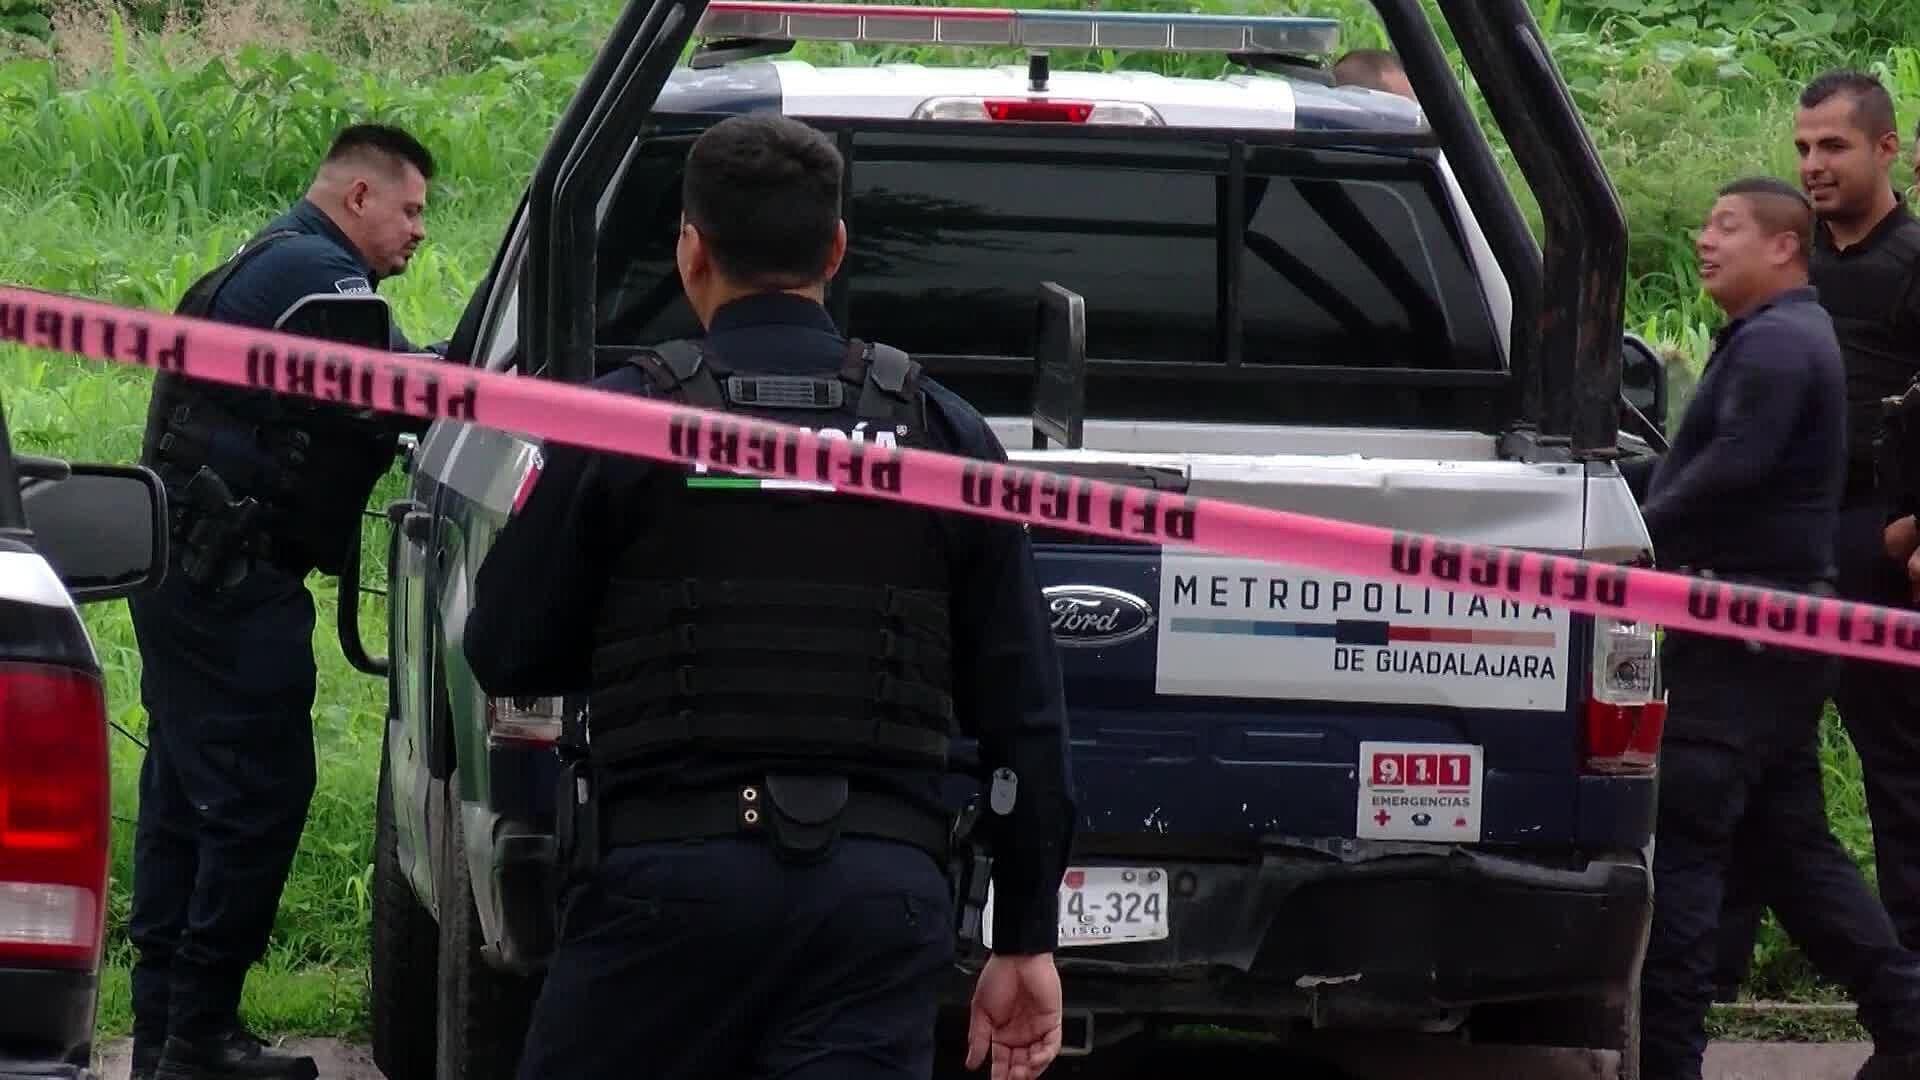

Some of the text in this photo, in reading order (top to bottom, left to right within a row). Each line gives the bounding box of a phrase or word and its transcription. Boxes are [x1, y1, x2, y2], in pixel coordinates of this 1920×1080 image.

[0, 302, 187, 372] PELIGR
[246, 346, 478, 420] PELIGRO
[669, 414, 902, 493] PELIGRO
[961, 464, 1197, 541] PELIGRO
[1391, 532, 1627, 607] PELIGRO
[1050, 597, 1120, 631] Ford
[1334, 647, 1556, 680] DE GUADALAJARA
[1376, 755, 1464, 784] 911
[1371, 796, 1471, 807] EMERGENCIAS
[1058, 891, 1161, 923] 4-324
[1060, 925, 1112, 935] LISCO
